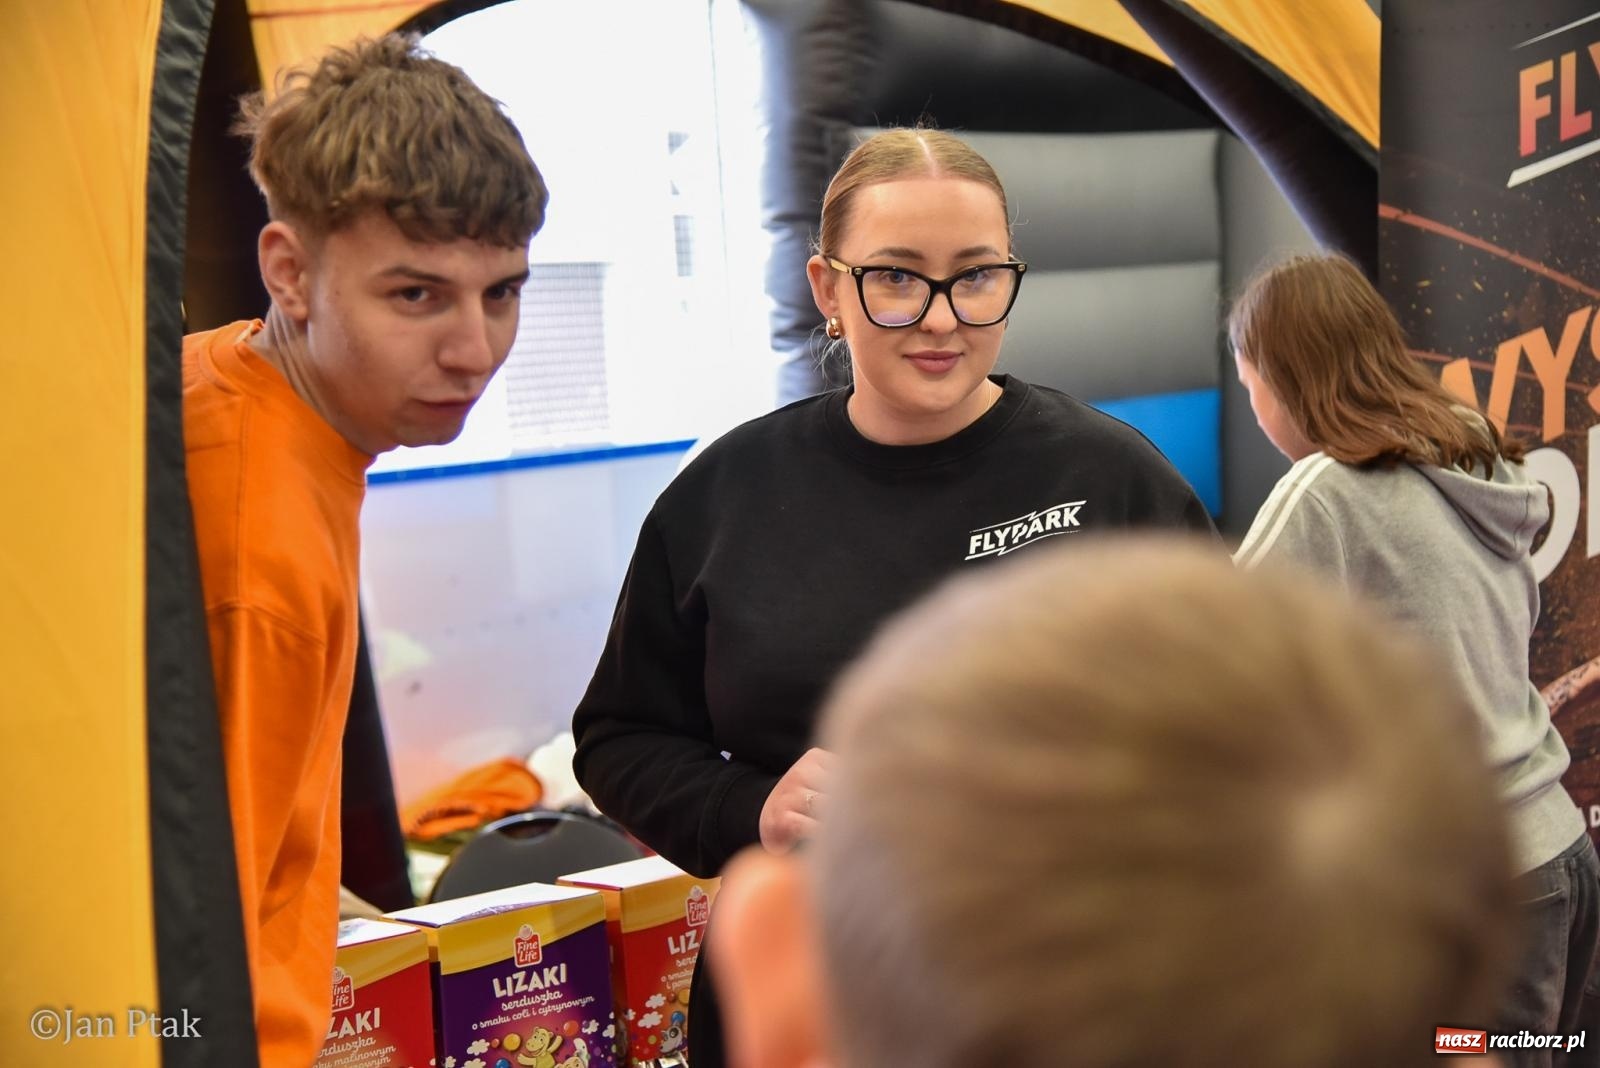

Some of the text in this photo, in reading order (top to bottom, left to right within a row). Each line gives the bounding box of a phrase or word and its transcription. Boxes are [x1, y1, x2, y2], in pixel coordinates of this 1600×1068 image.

[1519, 40, 1600, 157] FL
[968, 505, 1082, 555] FLYPARK
[517, 940, 538, 953] Fine
[667, 929, 700, 955] LIZ
[519, 951, 538, 963] Life
[333, 984, 350, 996] ine
[492, 963, 567, 998] LIZAKI
[332, 994, 350, 1007] ife
[501, 990, 564, 1012] serduszka
[325, 1007, 381, 1040] ZAKI
[472, 995, 595, 1031] o smaku coli i cytrynowym
[317, 1036, 377, 1058] rduszka
[334, 1045, 396, 1067] malinowym
